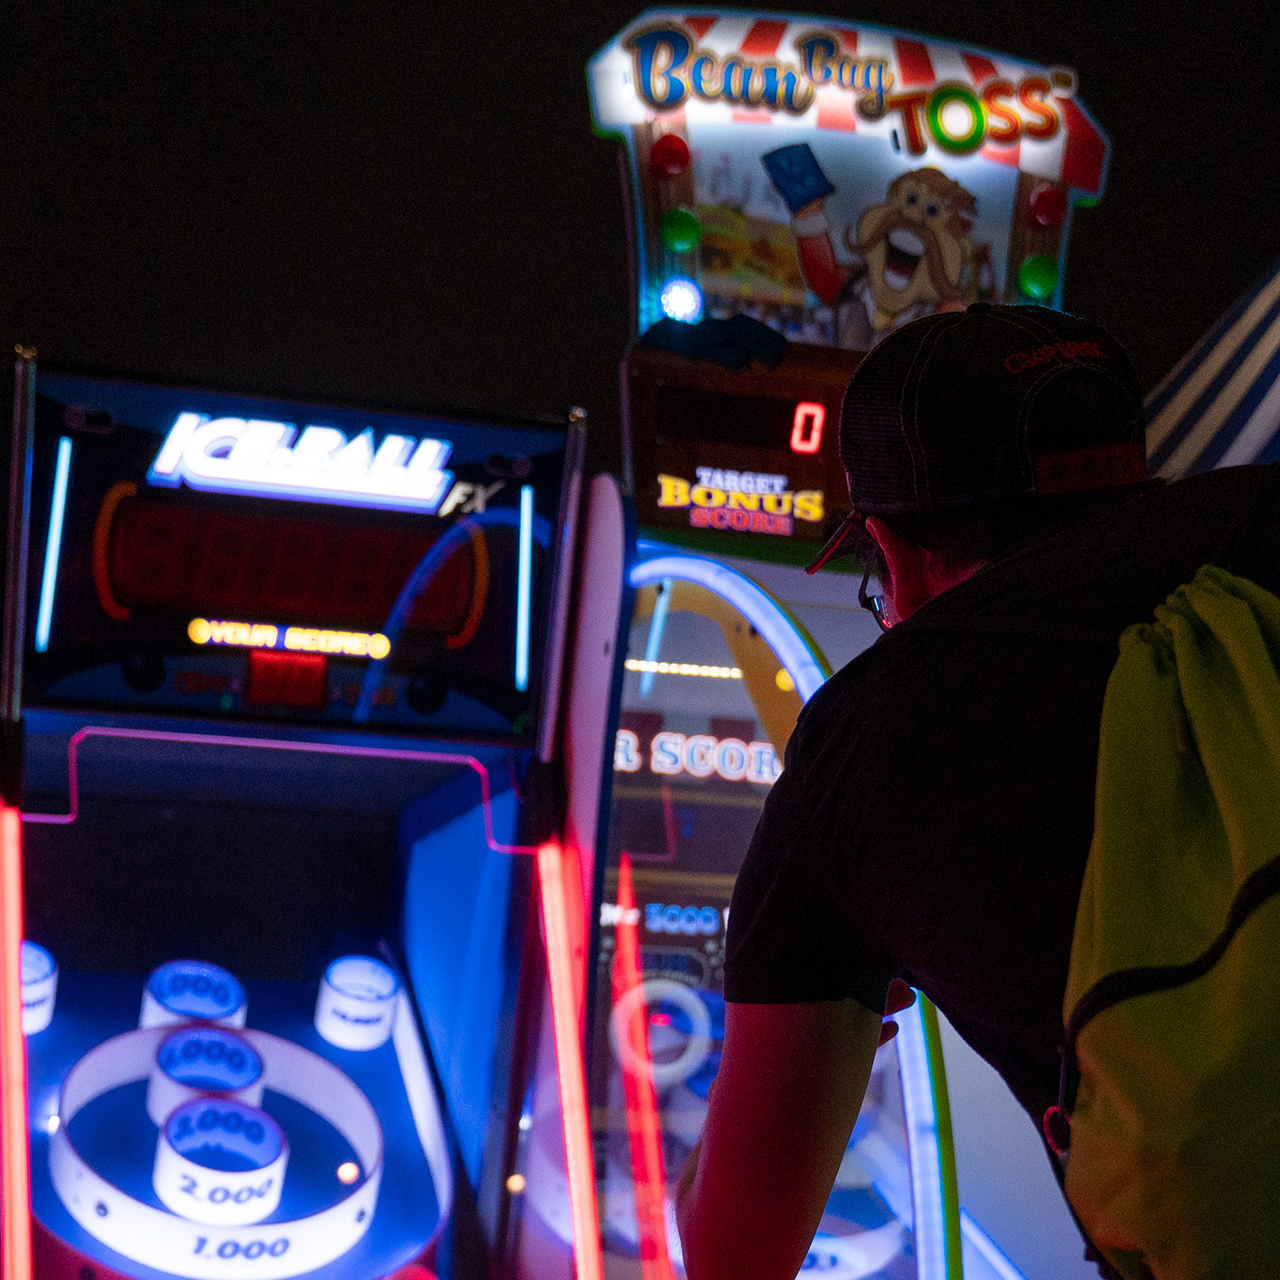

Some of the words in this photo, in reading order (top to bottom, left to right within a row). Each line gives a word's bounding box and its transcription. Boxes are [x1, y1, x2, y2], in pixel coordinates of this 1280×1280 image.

[627, 22, 814, 116] Bean
[794, 30, 894, 120] Bag
[790, 402, 826, 454] 0
[438, 480, 505, 518] FX
[657, 473, 824, 522] BONUS
[695, 465, 789, 493] TARGET
[689, 507, 795, 536] SCORE
[650, 731, 785, 784] SCOR
